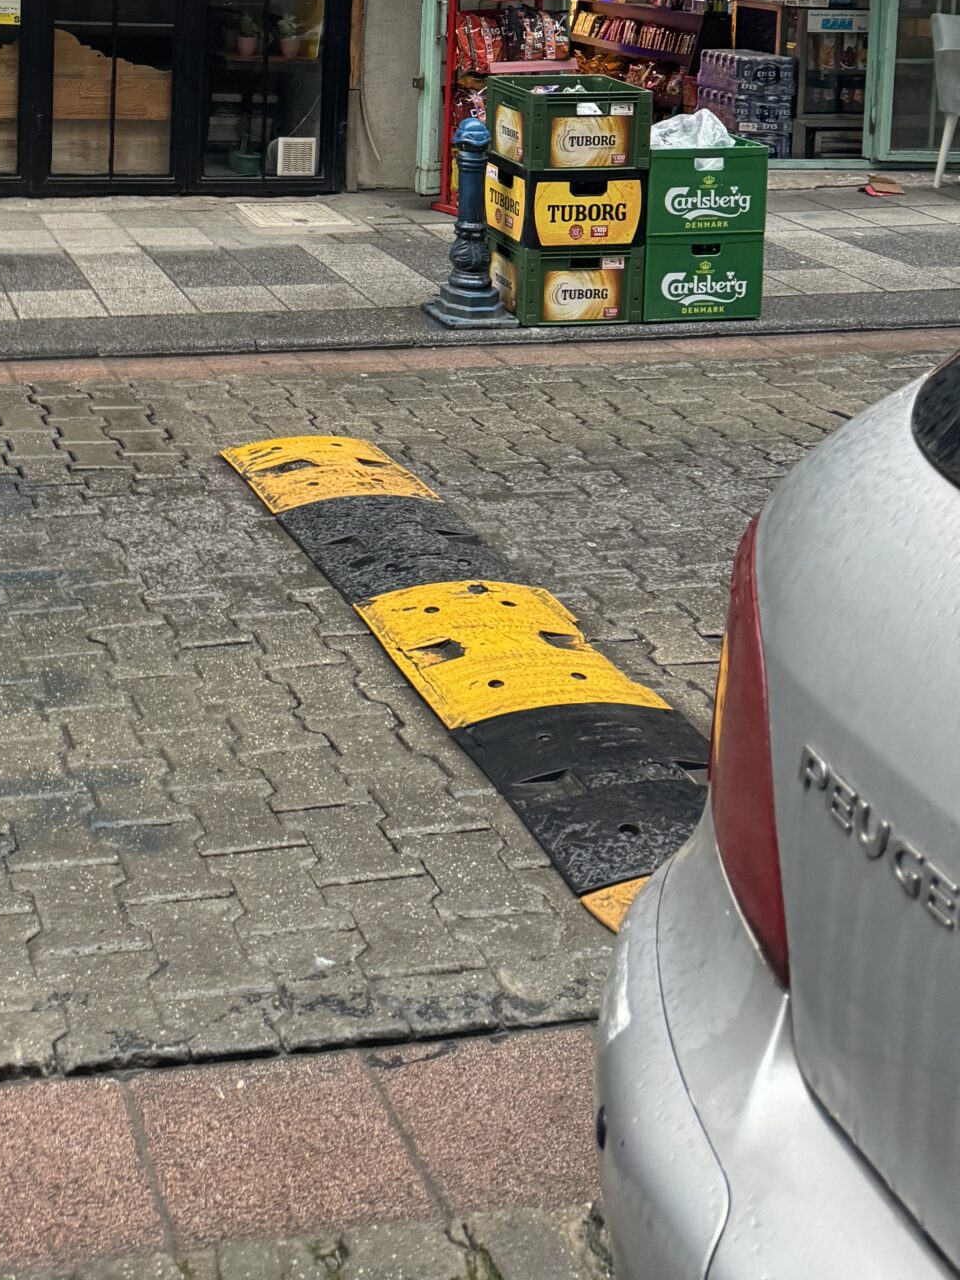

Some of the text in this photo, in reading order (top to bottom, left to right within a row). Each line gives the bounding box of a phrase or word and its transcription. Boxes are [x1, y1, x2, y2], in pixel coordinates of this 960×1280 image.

[501, 124, 519, 140] TUBORG
[569, 134, 616, 147] TUBORG
[489, 187, 520, 216] TUBORG
[664, 186, 752, 219] Carlsberg
[547, 203, 627, 223] TUBORG
[685, 220, 729, 230] DENMARK
[561, 288, 609, 301] TUBORG
[661, 272, 748, 304] Carlsberg
[682, 306, 725, 315] DENMARK
[799, 743, 960, 932] PEUGE
